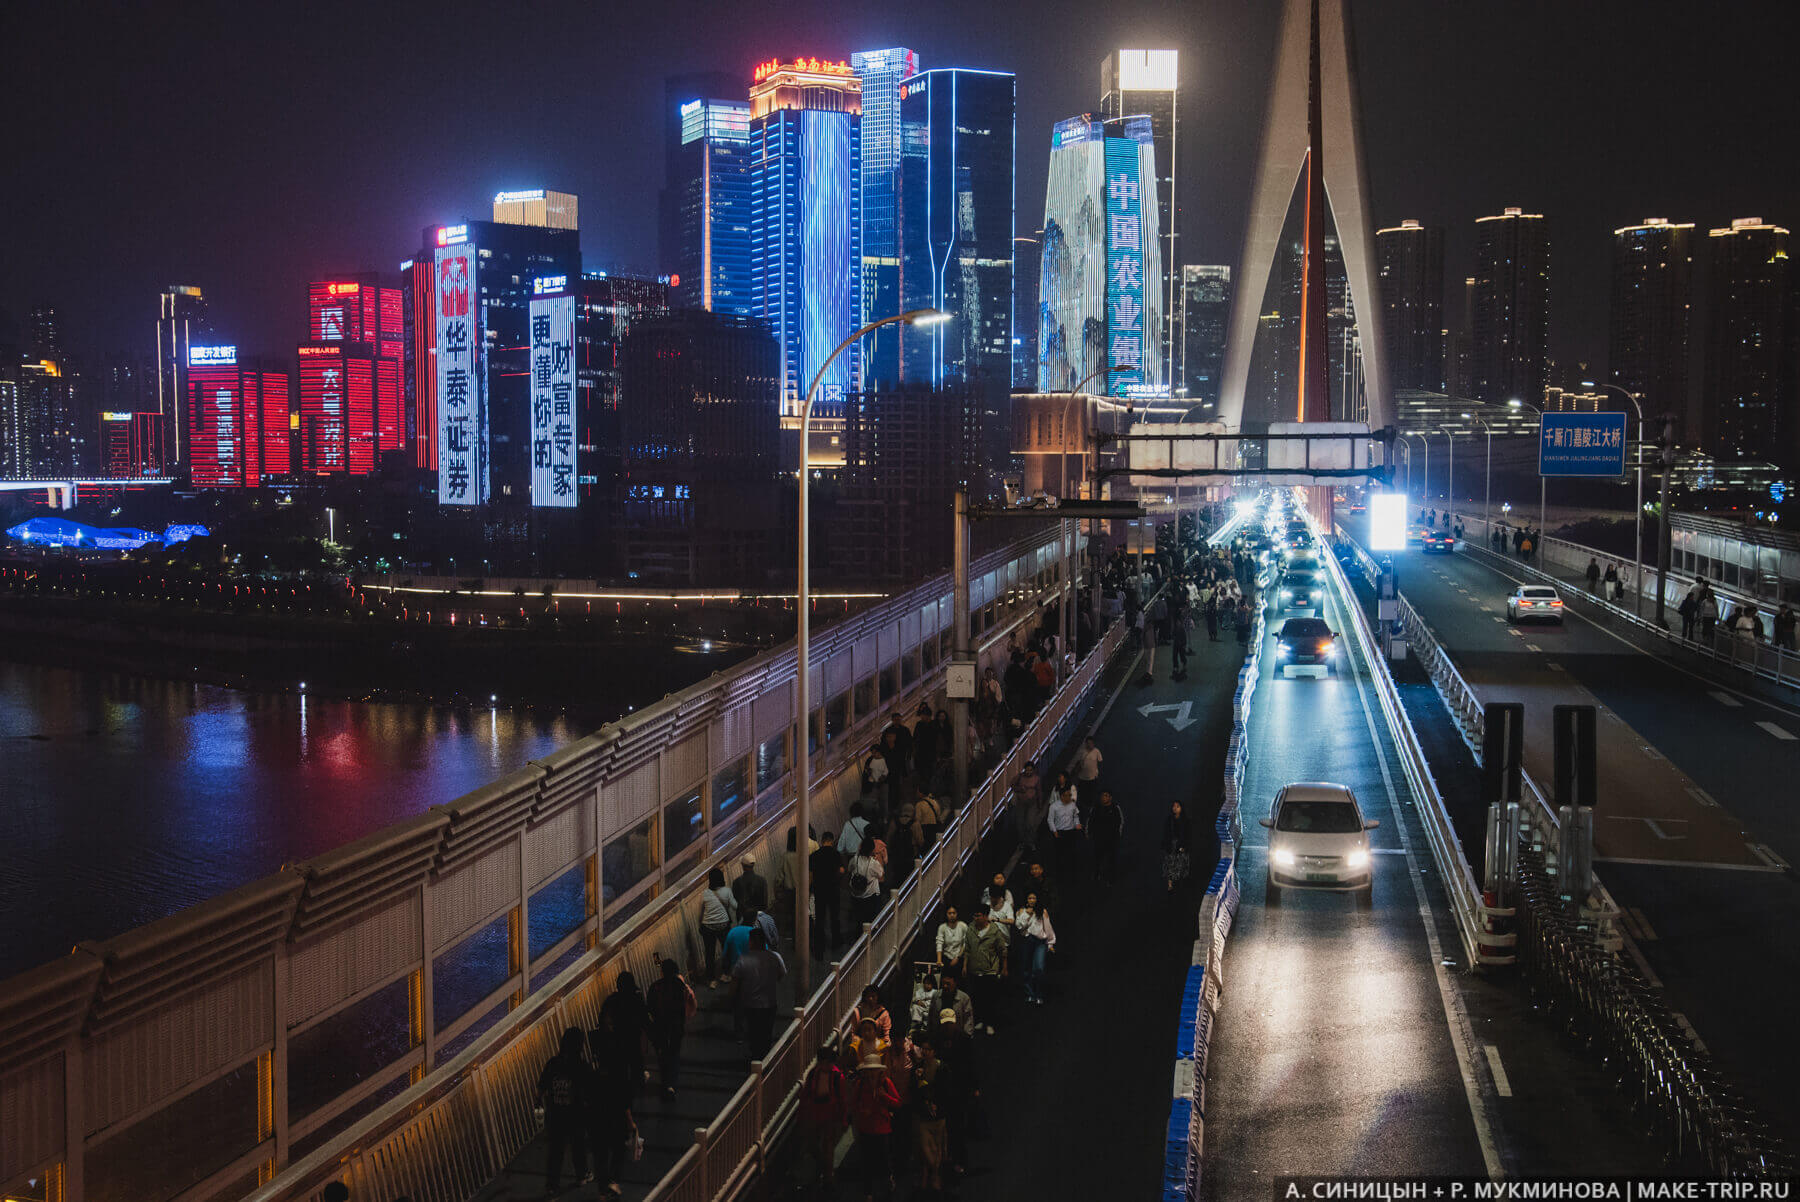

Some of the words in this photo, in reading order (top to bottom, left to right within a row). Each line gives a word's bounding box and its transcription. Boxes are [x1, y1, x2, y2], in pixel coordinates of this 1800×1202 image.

[446, 321, 469, 498] 华泰证券
[532, 314, 551, 469] 更懂你的
[1544, 427, 1621, 448] 千厮门嘉陵江大桥
